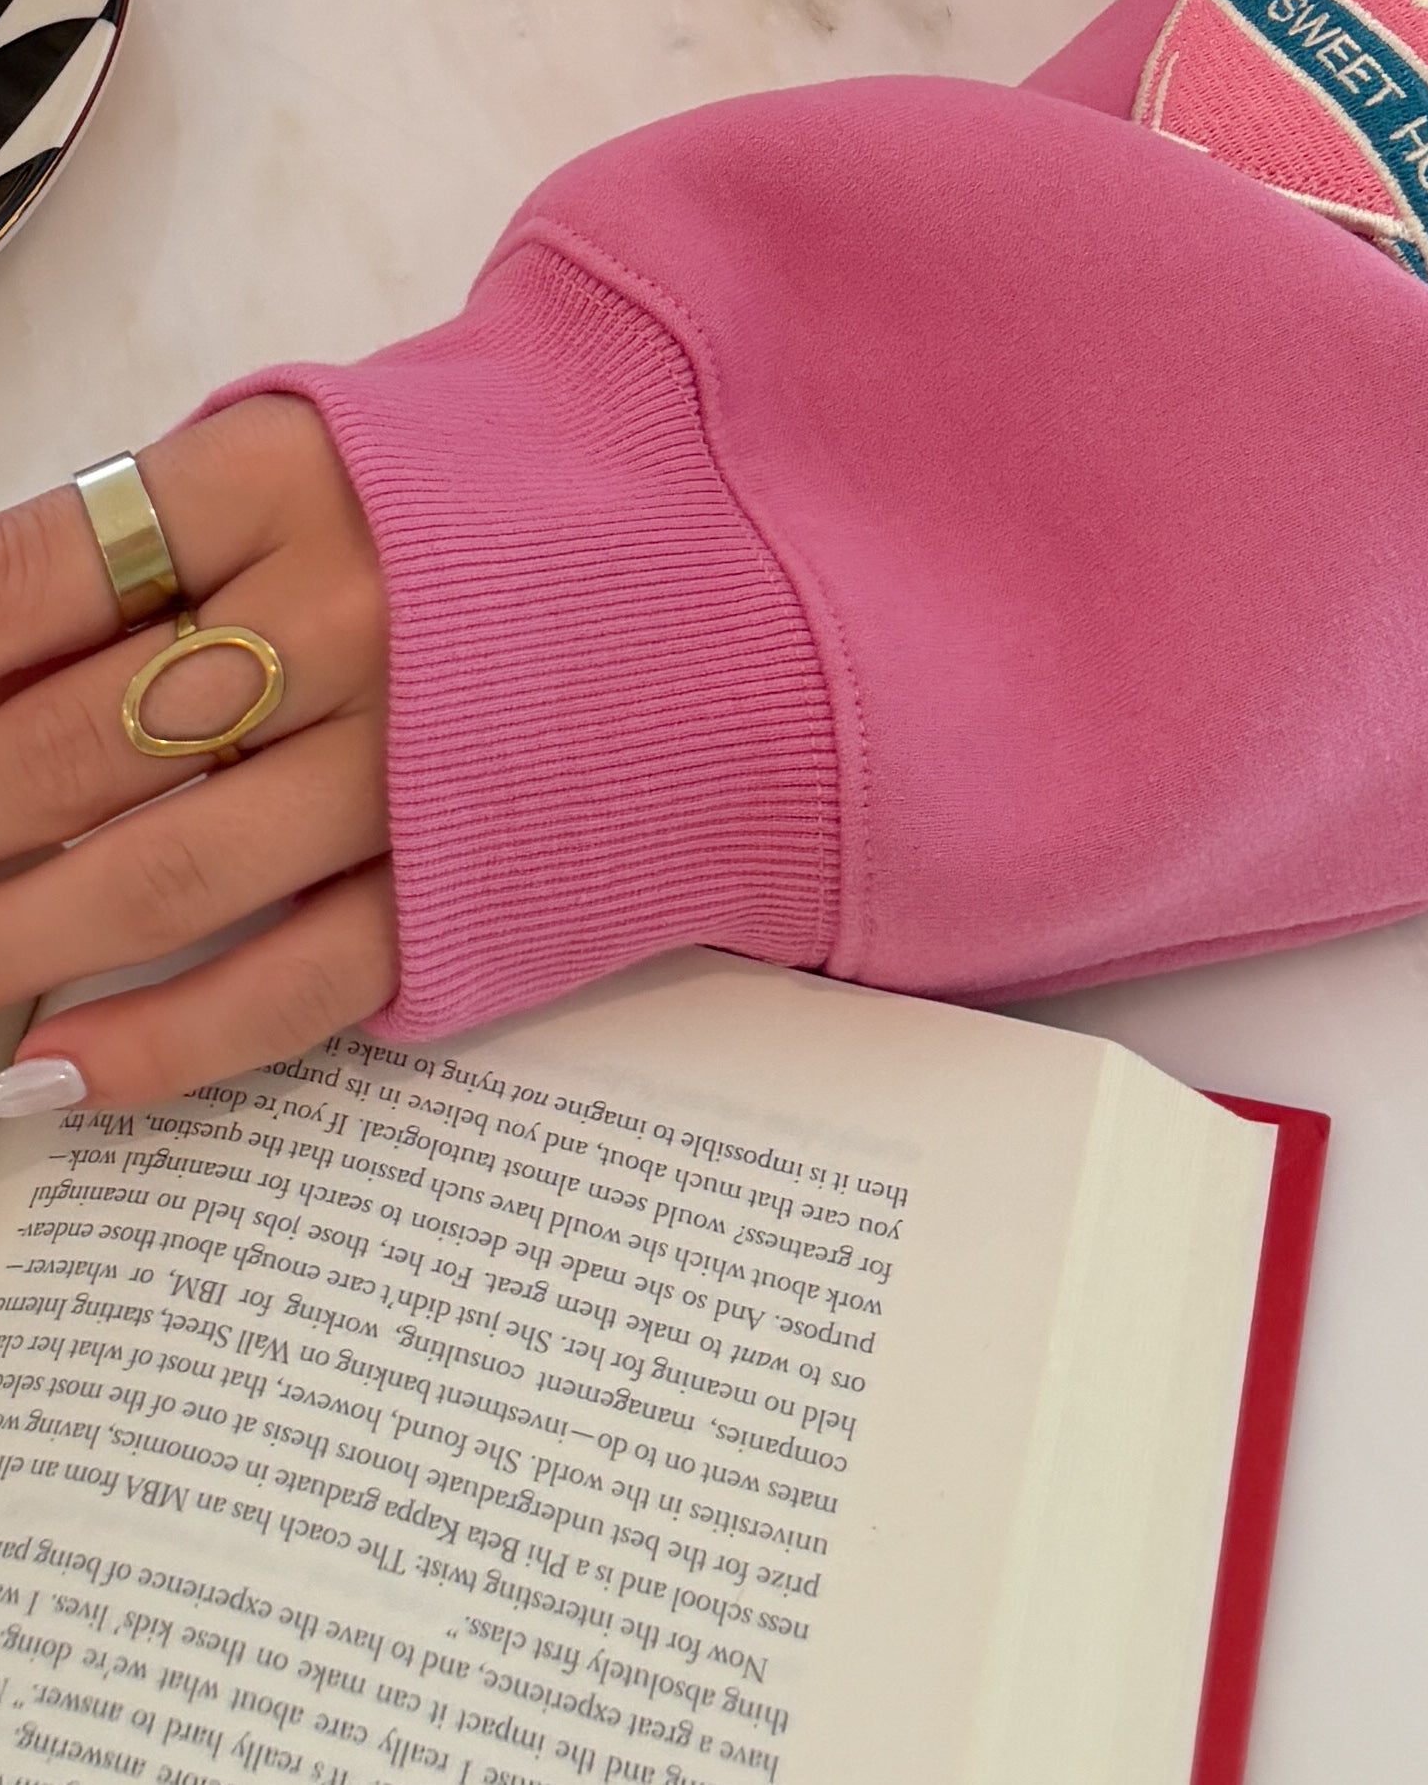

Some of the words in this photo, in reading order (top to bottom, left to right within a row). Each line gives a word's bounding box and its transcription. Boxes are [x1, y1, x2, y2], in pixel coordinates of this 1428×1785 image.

[324, 1036, 341, 1057] it
[347, 1040, 409, 1068] make
[413, 1058, 436, 1079] to
[440, 1059, 506, 1099] trying
[344, 1078, 372, 1102] its
[378, 1085, 402, 1110] in
[510, 1085, 550, 1107] not
[407, 1094, 489, 1137] believe
[495, 1118, 541, 1142] you
[553, 1096, 647, 1140] imagine
[541, 1131, 589, 1155] and
[653, 1124, 675, 1147] to
[596, 1142, 668, 1183] about,
[680, 1131, 804, 1184] impossible
[675, 1168, 743, 1200] much
[809, 1166, 827, 1190] is
[831, 1171, 850, 1195] it
[856, 1177, 908, 1210] then
[747, 1188, 794, 1220] that
[800, 1203, 851, 1228] care
[17, 1221, 94, 1245] endeav-
[97, 1224, 157, 1253] those
[858, 1216, 904, 1240] you
[158, 1232, 228, 1264] about
[232, 1242, 321, 1280] enough
[326, 1269, 377, 1295] care
[455, 1305, 502, 1338] just
[505, 1320, 553, 1354] She
[561, 1336, 607, 1372] her.
[609, 1351, 646, 1383] for
[650, 1355, 757, 1406] meaning
[764, 1395, 796, 1417] no
[23, 1408, 101, 1451] having
[800, 1405, 857, 1442] held
[108, 1423, 239, 1472] economics,
[30, 1458, 60, 1478] an
[63, 1463, 120, 1497] from
[245, 1460, 270, 1488] in
[127, 1474, 191, 1513] MBA
[196, 1492, 228, 1513] an
[274, 1468, 382, 1512] graduate
[230, 1501, 273, 1536] has
[279, 1514, 352, 1549] coach
[384, 1498, 461, 1546] Kappa
[356, 1537, 404, 1575] The
[467, 1525, 522, 1564] Beta
[525, 1543, 570, 1579] Phi
[415, 1554, 478, 1594] twist:
[575, 1558, 591, 1576] a
[594, 1564, 615, 1591] is
[617, 1571, 668, 1599] and
[482, 1568, 614, 1638] interesting
[670, 1587, 754, 1628] school
[620, 1617, 660, 1651] the
[757, 1612, 810, 1641] ness
[532, 1637, 581, 1676] first
[665, 1631, 702, 1665] for
[706, 1644, 769, 1684] Now
[585, 1647, 717, 1714] absolutely
[721, 1686, 789, 1737] thing
